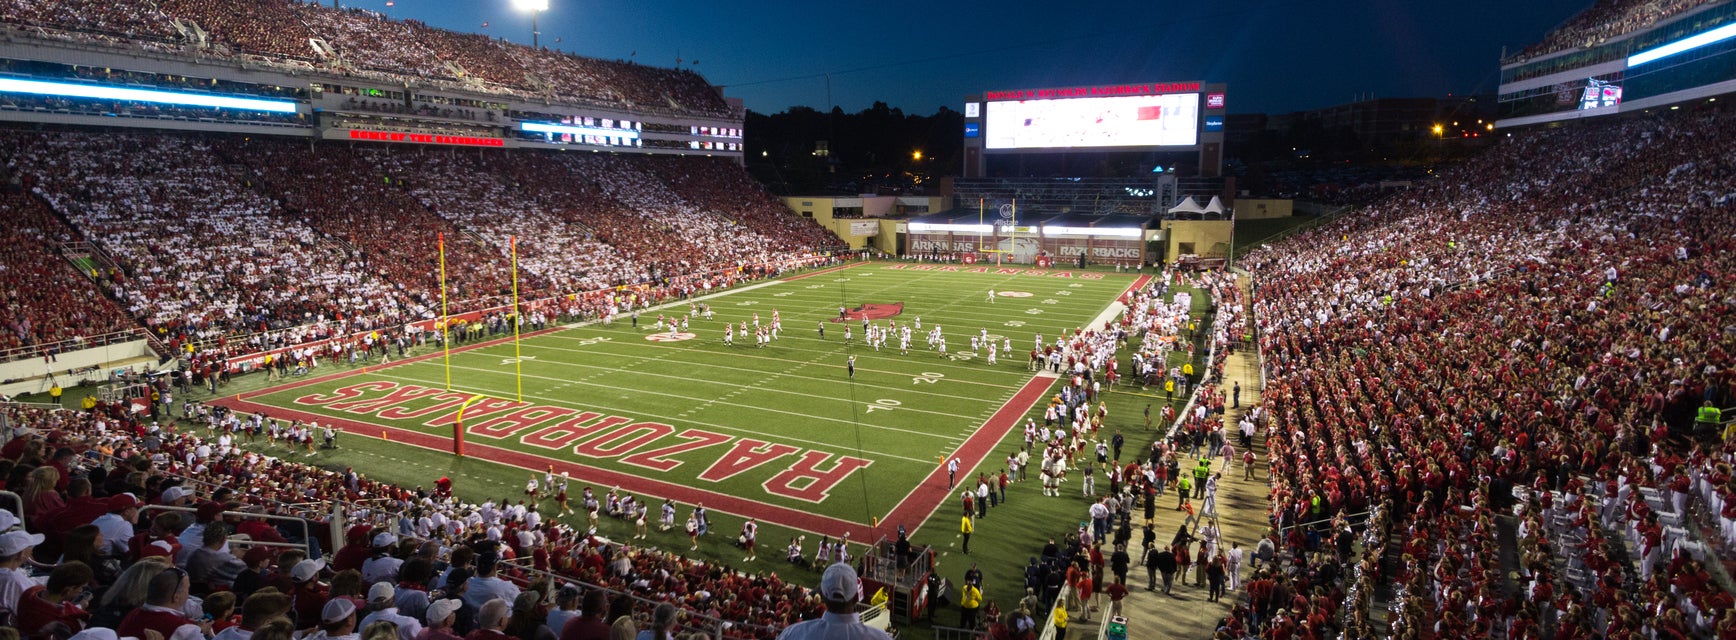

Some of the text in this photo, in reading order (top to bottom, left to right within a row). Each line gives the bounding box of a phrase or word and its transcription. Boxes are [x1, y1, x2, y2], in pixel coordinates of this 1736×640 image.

[1091, 84, 1151, 95] RAZORBACK
[1154, 82, 1200, 92] STADIUM
[994, 218, 1019, 226] Allstae
[913, 371, 944, 384] 20
[867, 398, 902, 411] 10
[293, 381, 874, 504] RAZORBACKS
